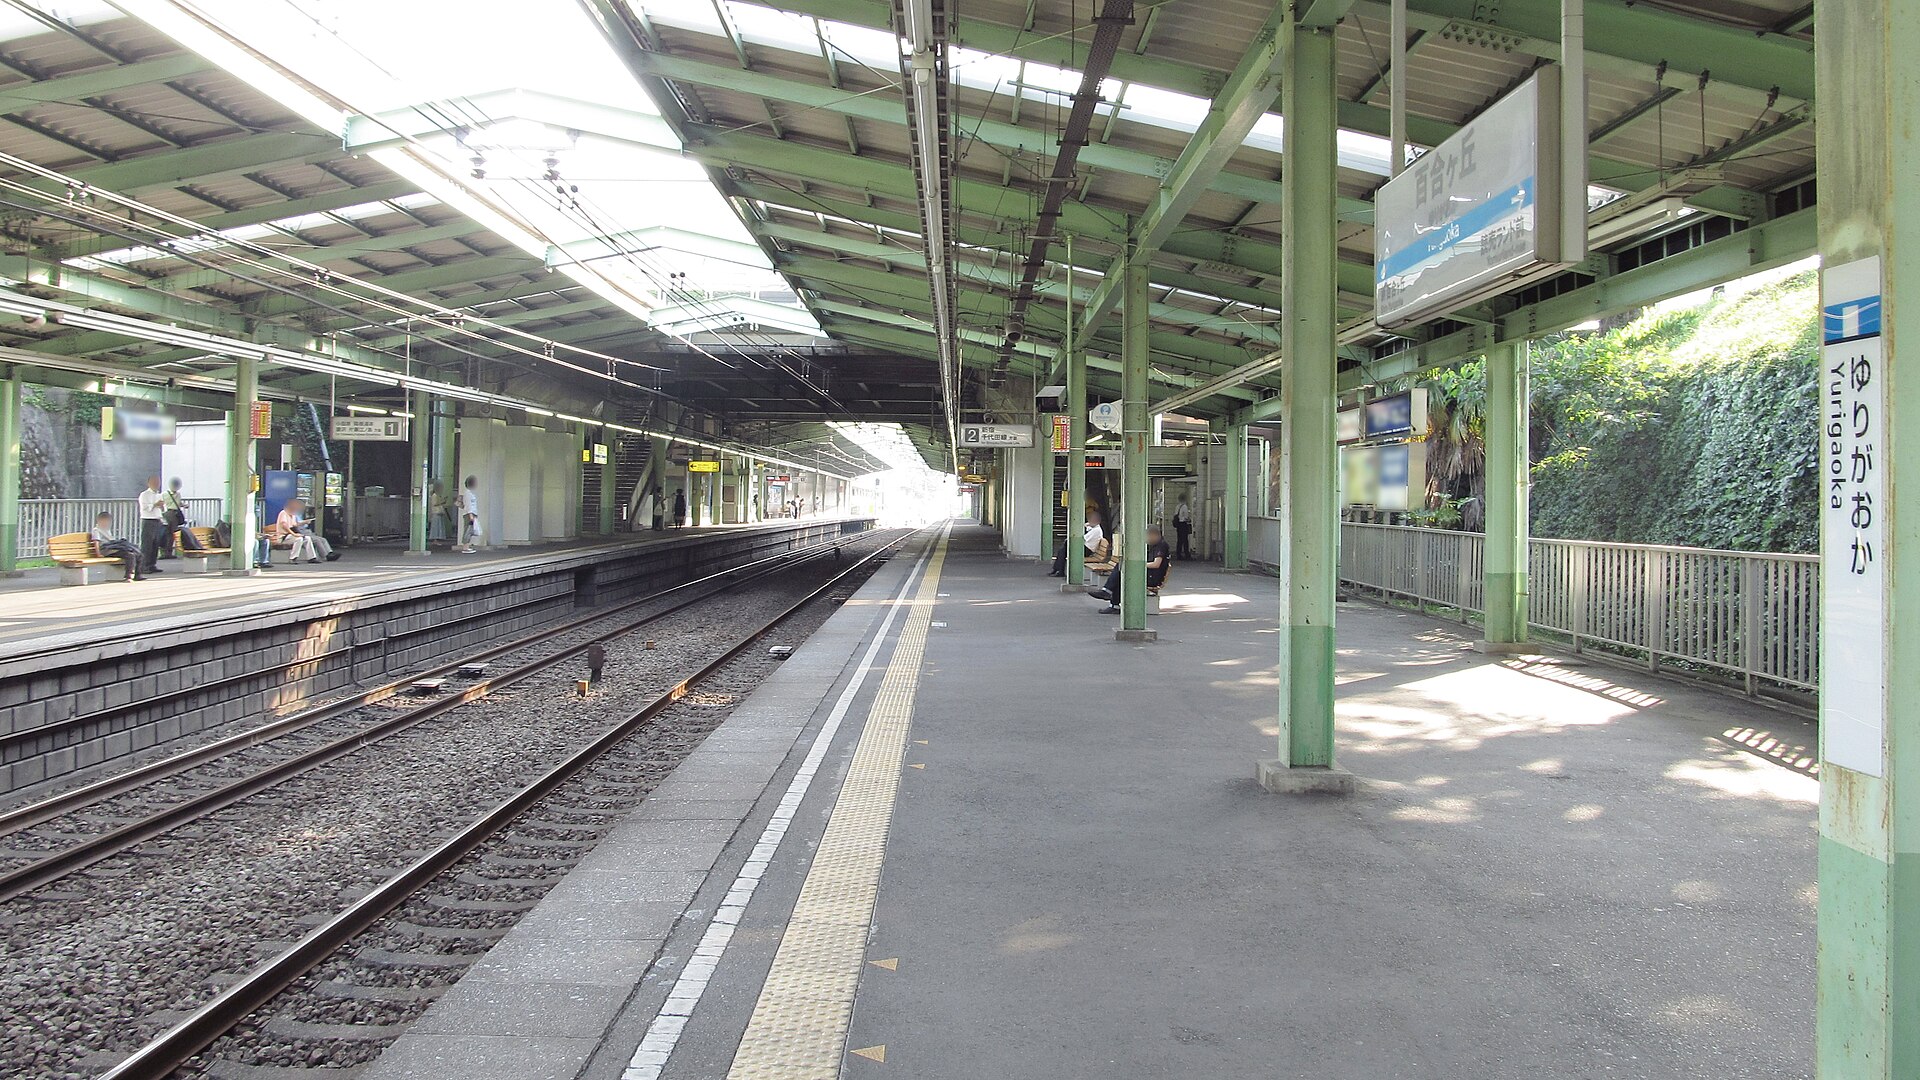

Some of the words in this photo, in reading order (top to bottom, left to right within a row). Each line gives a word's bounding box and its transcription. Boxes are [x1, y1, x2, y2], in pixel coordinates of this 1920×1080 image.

[1415, 127, 1476, 209] 百合ヶ丘
[967, 429, 977, 442] 2
[1827, 361, 1847, 510] Yurigaoka
[1850, 354, 1873, 576] ゆりがおか
